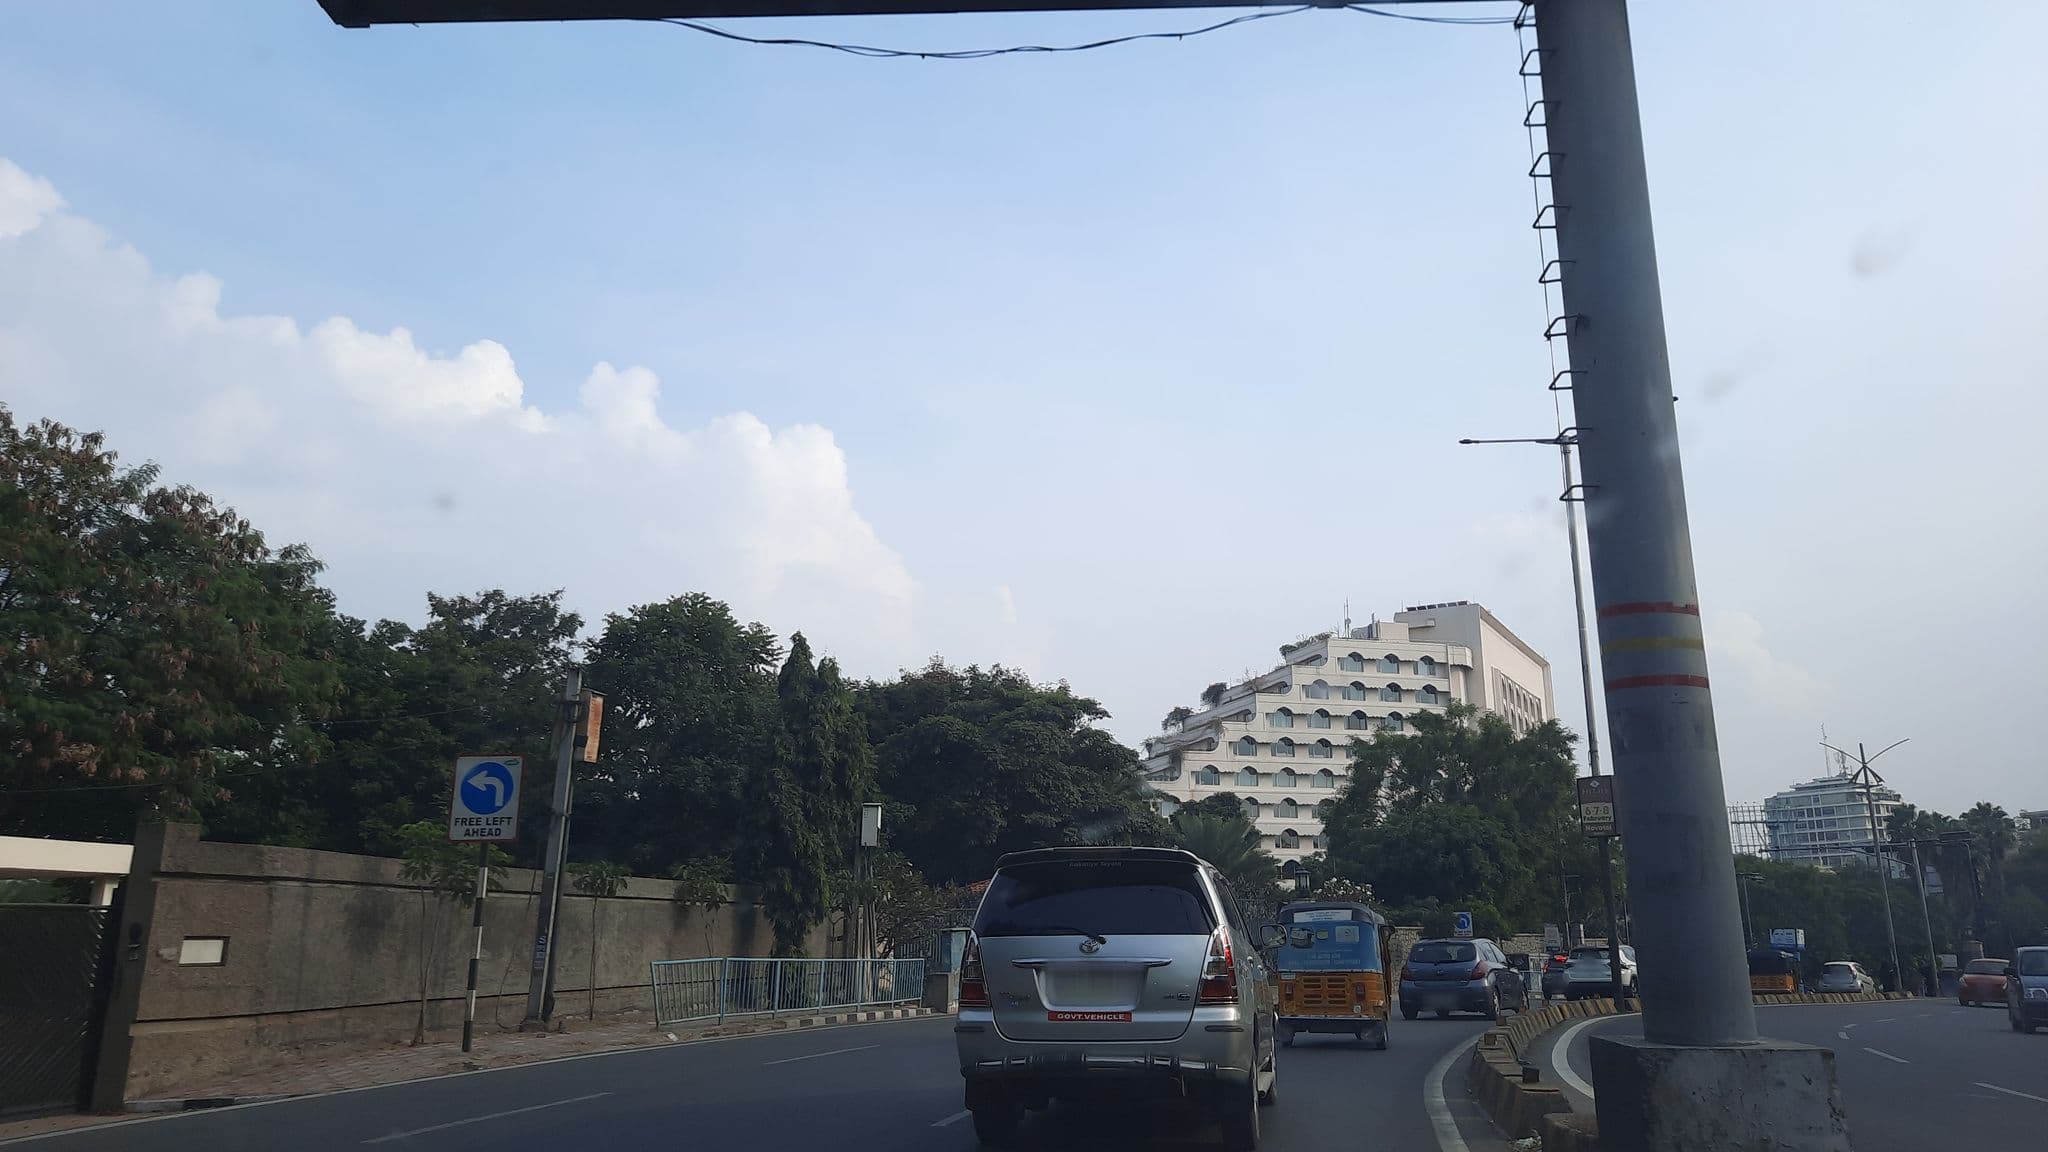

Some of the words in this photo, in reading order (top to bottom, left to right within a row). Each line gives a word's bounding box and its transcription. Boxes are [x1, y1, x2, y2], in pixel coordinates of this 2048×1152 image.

[454, 817, 482, 826] FREE
[486, 816, 512, 826] LEFT
[464, 828, 502, 837] AHEAD
